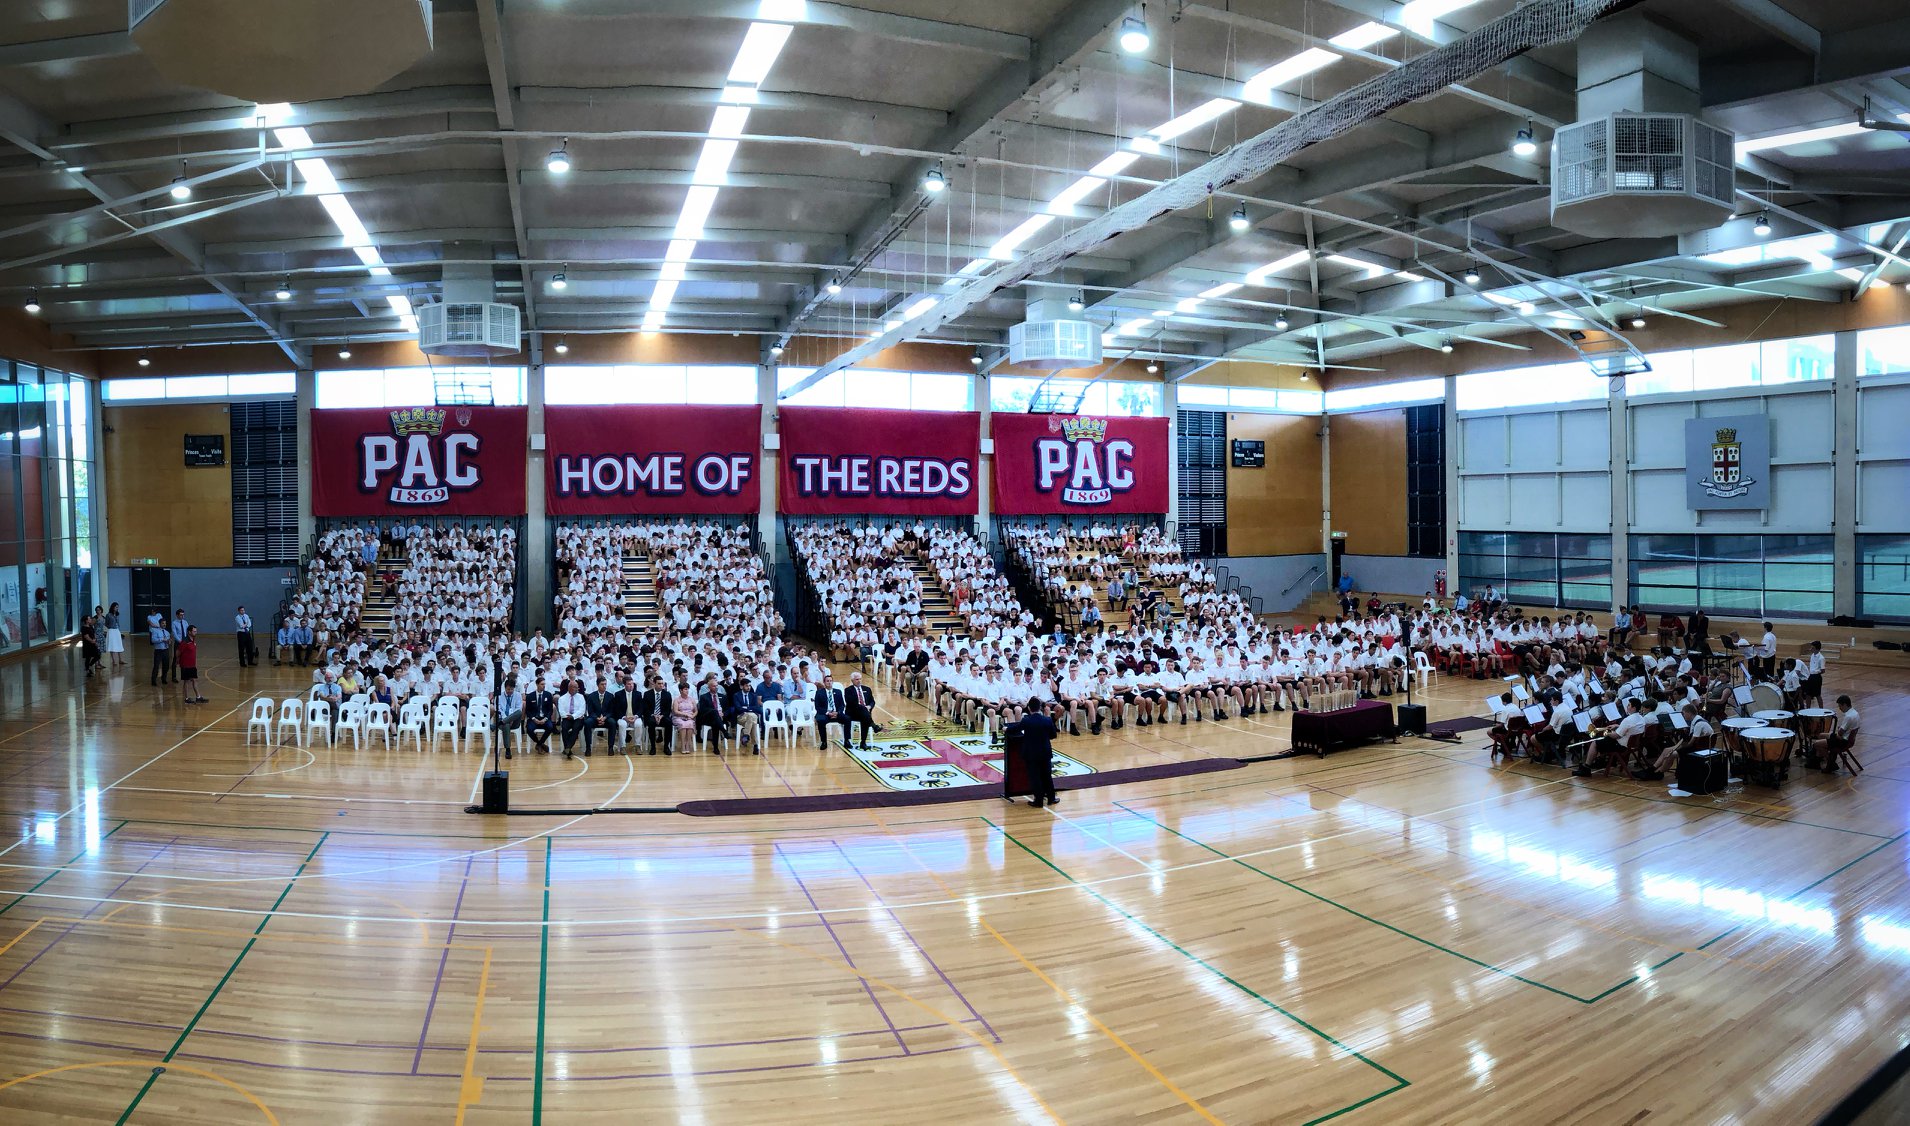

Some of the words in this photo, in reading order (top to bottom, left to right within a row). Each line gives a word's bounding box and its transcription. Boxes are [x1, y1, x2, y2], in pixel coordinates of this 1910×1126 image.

[363, 433, 479, 488] PAC
[561, 456, 684, 492] HOME
[697, 456, 751, 491] OF
[796, 458, 871, 492] THE
[880, 459, 970, 494] REDS
[1037, 439, 1135, 489] PAC
[396, 488, 446, 502] 1869
[1068, 489, 1110, 502] 1869
